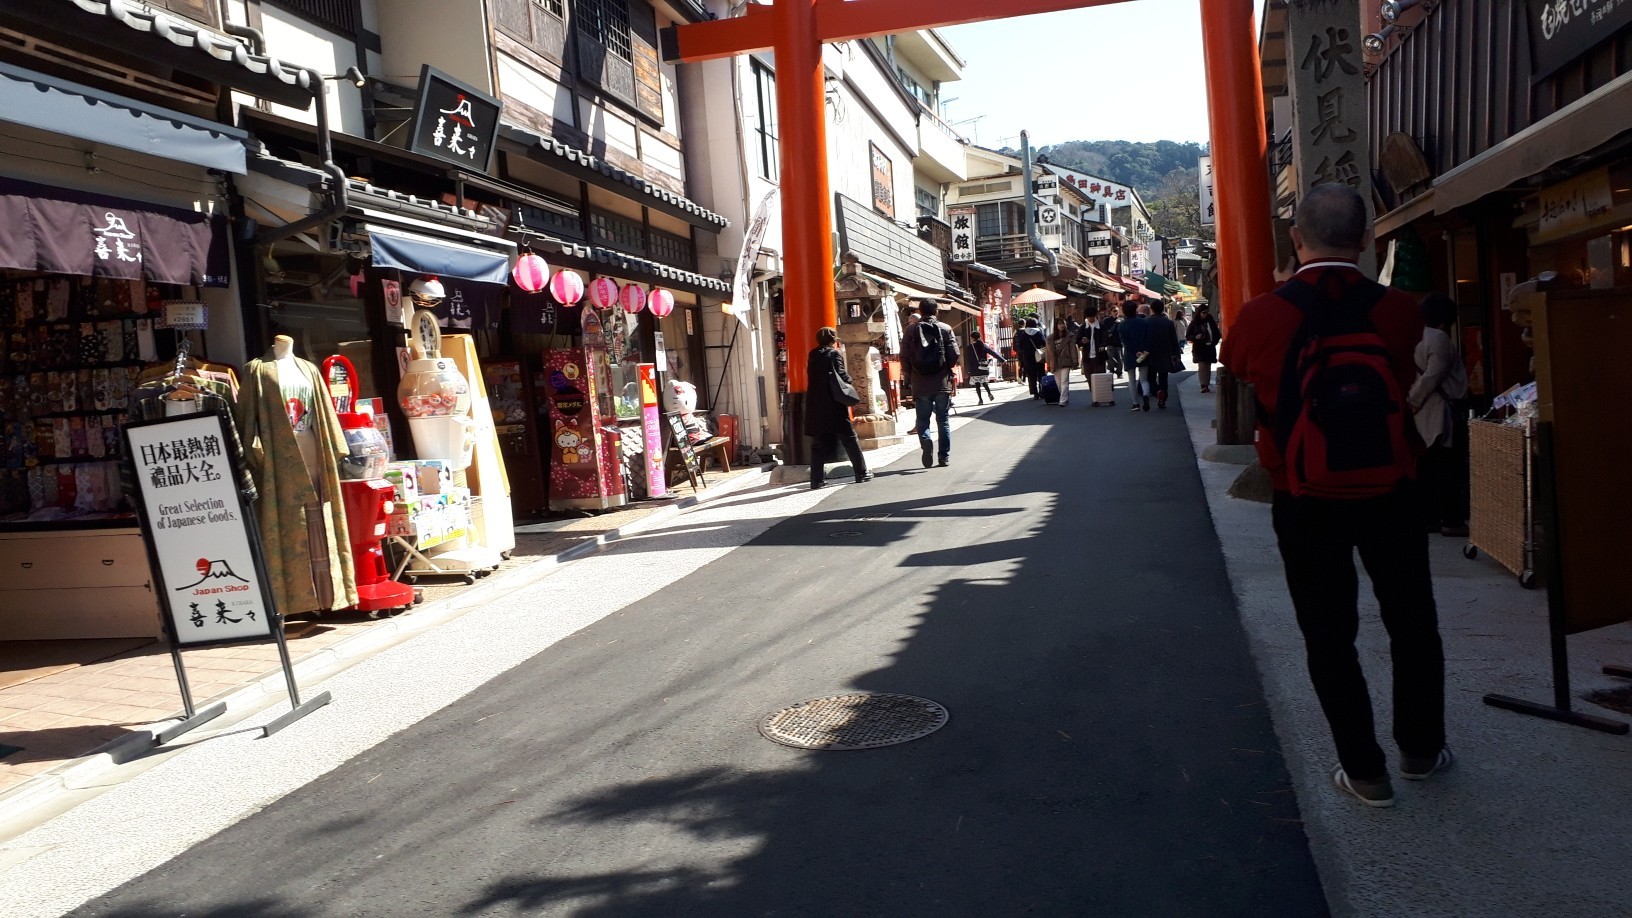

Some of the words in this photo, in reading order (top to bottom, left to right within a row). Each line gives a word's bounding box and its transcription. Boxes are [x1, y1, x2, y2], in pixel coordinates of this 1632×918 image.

[954, 215, 970, 250] 旅館
[140, 434, 221, 466] 日本最熱銷
[150, 460, 222, 488] 禮品大全。
[159, 503, 183, 516] Great
[186, 498, 225, 513] Selection
[157, 517, 165, 530] of
[167, 514, 206, 530] Japanese
[208, 509, 238, 523] Goods.
[192, 587, 223, 596] Japan
[225, 584, 249, 593] Shop
